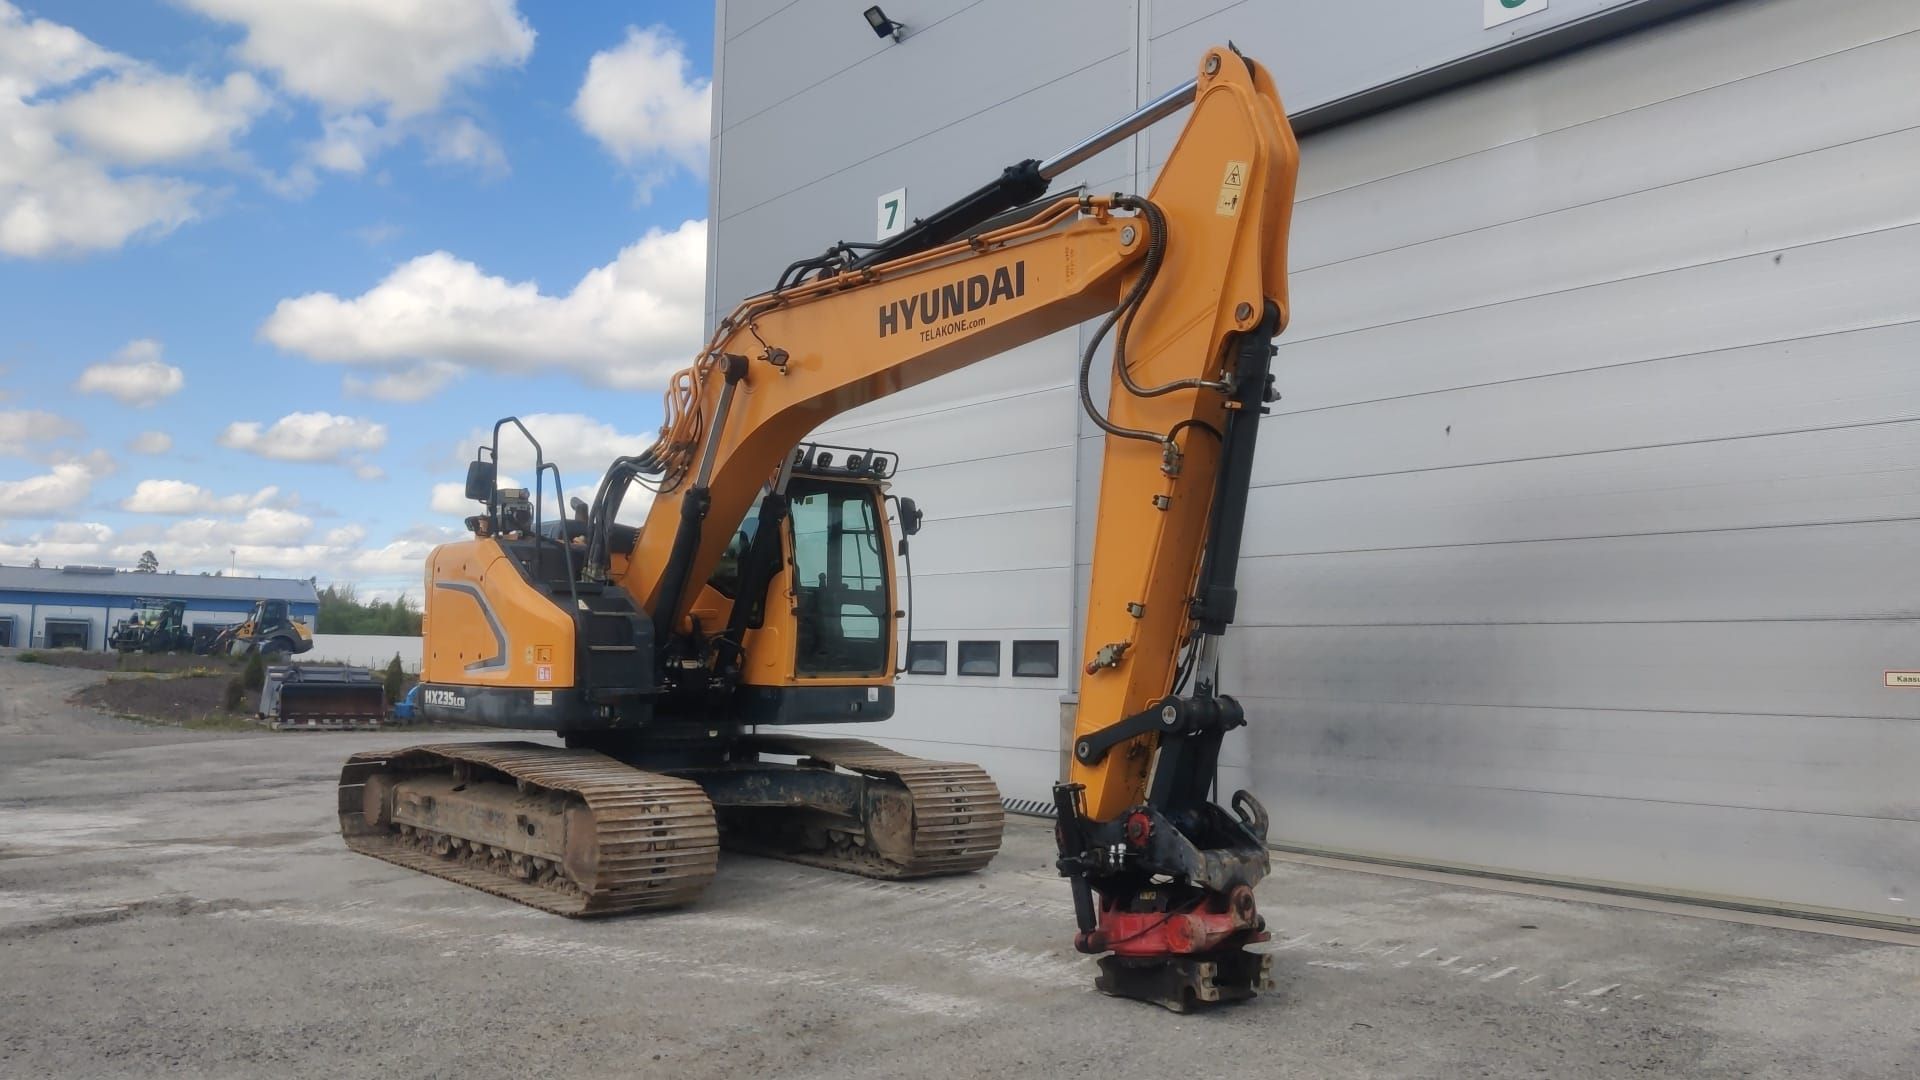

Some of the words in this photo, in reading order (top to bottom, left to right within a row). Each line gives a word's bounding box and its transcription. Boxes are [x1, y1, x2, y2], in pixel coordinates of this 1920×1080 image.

[885, 199, 898, 230] 7
[879, 260, 1025, 338] HYUNDAI
[920, 317, 986, 342] TELAKONE.com
